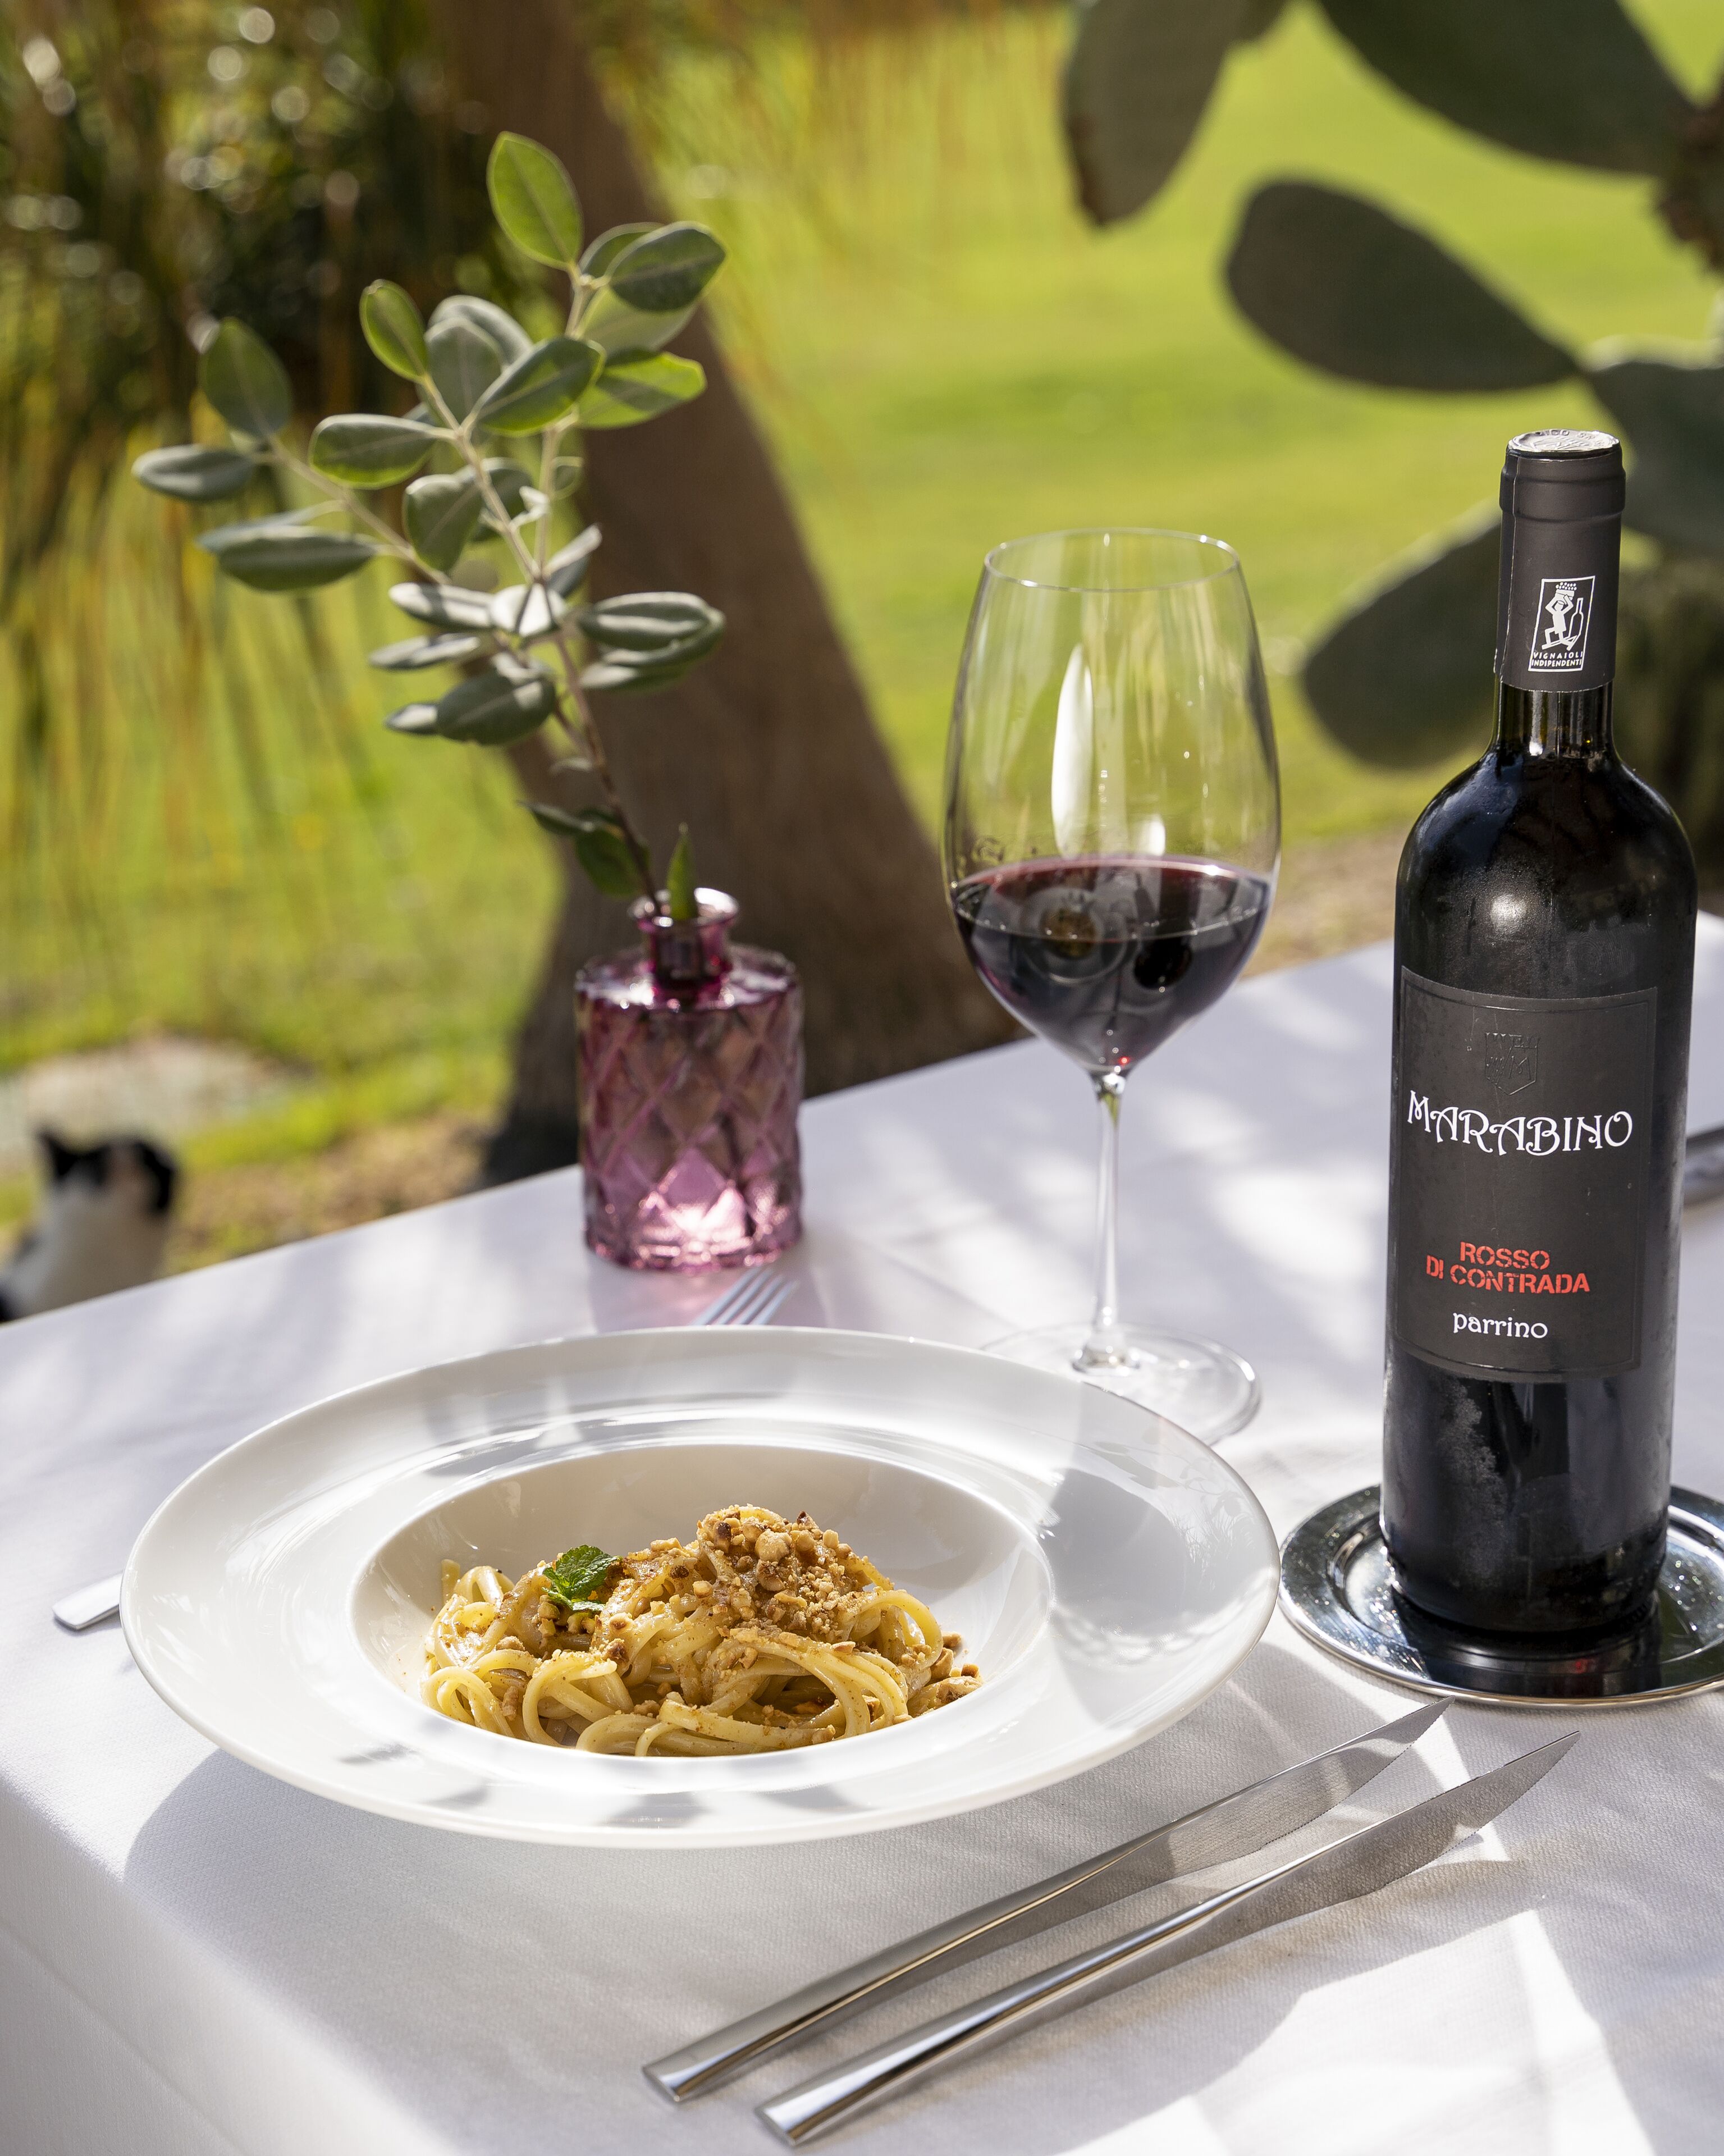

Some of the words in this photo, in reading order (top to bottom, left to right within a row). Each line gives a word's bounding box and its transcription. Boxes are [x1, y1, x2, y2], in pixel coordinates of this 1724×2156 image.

[1407, 1090, 1632, 1156] MARABINO
[1460, 1241, 1551, 1270] ROSSO
[1426, 1255, 1444, 1279] DI
[1449, 1264, 1590, 1294] CONTRADA
[1453, 1312, 1548, 1339] parrino
